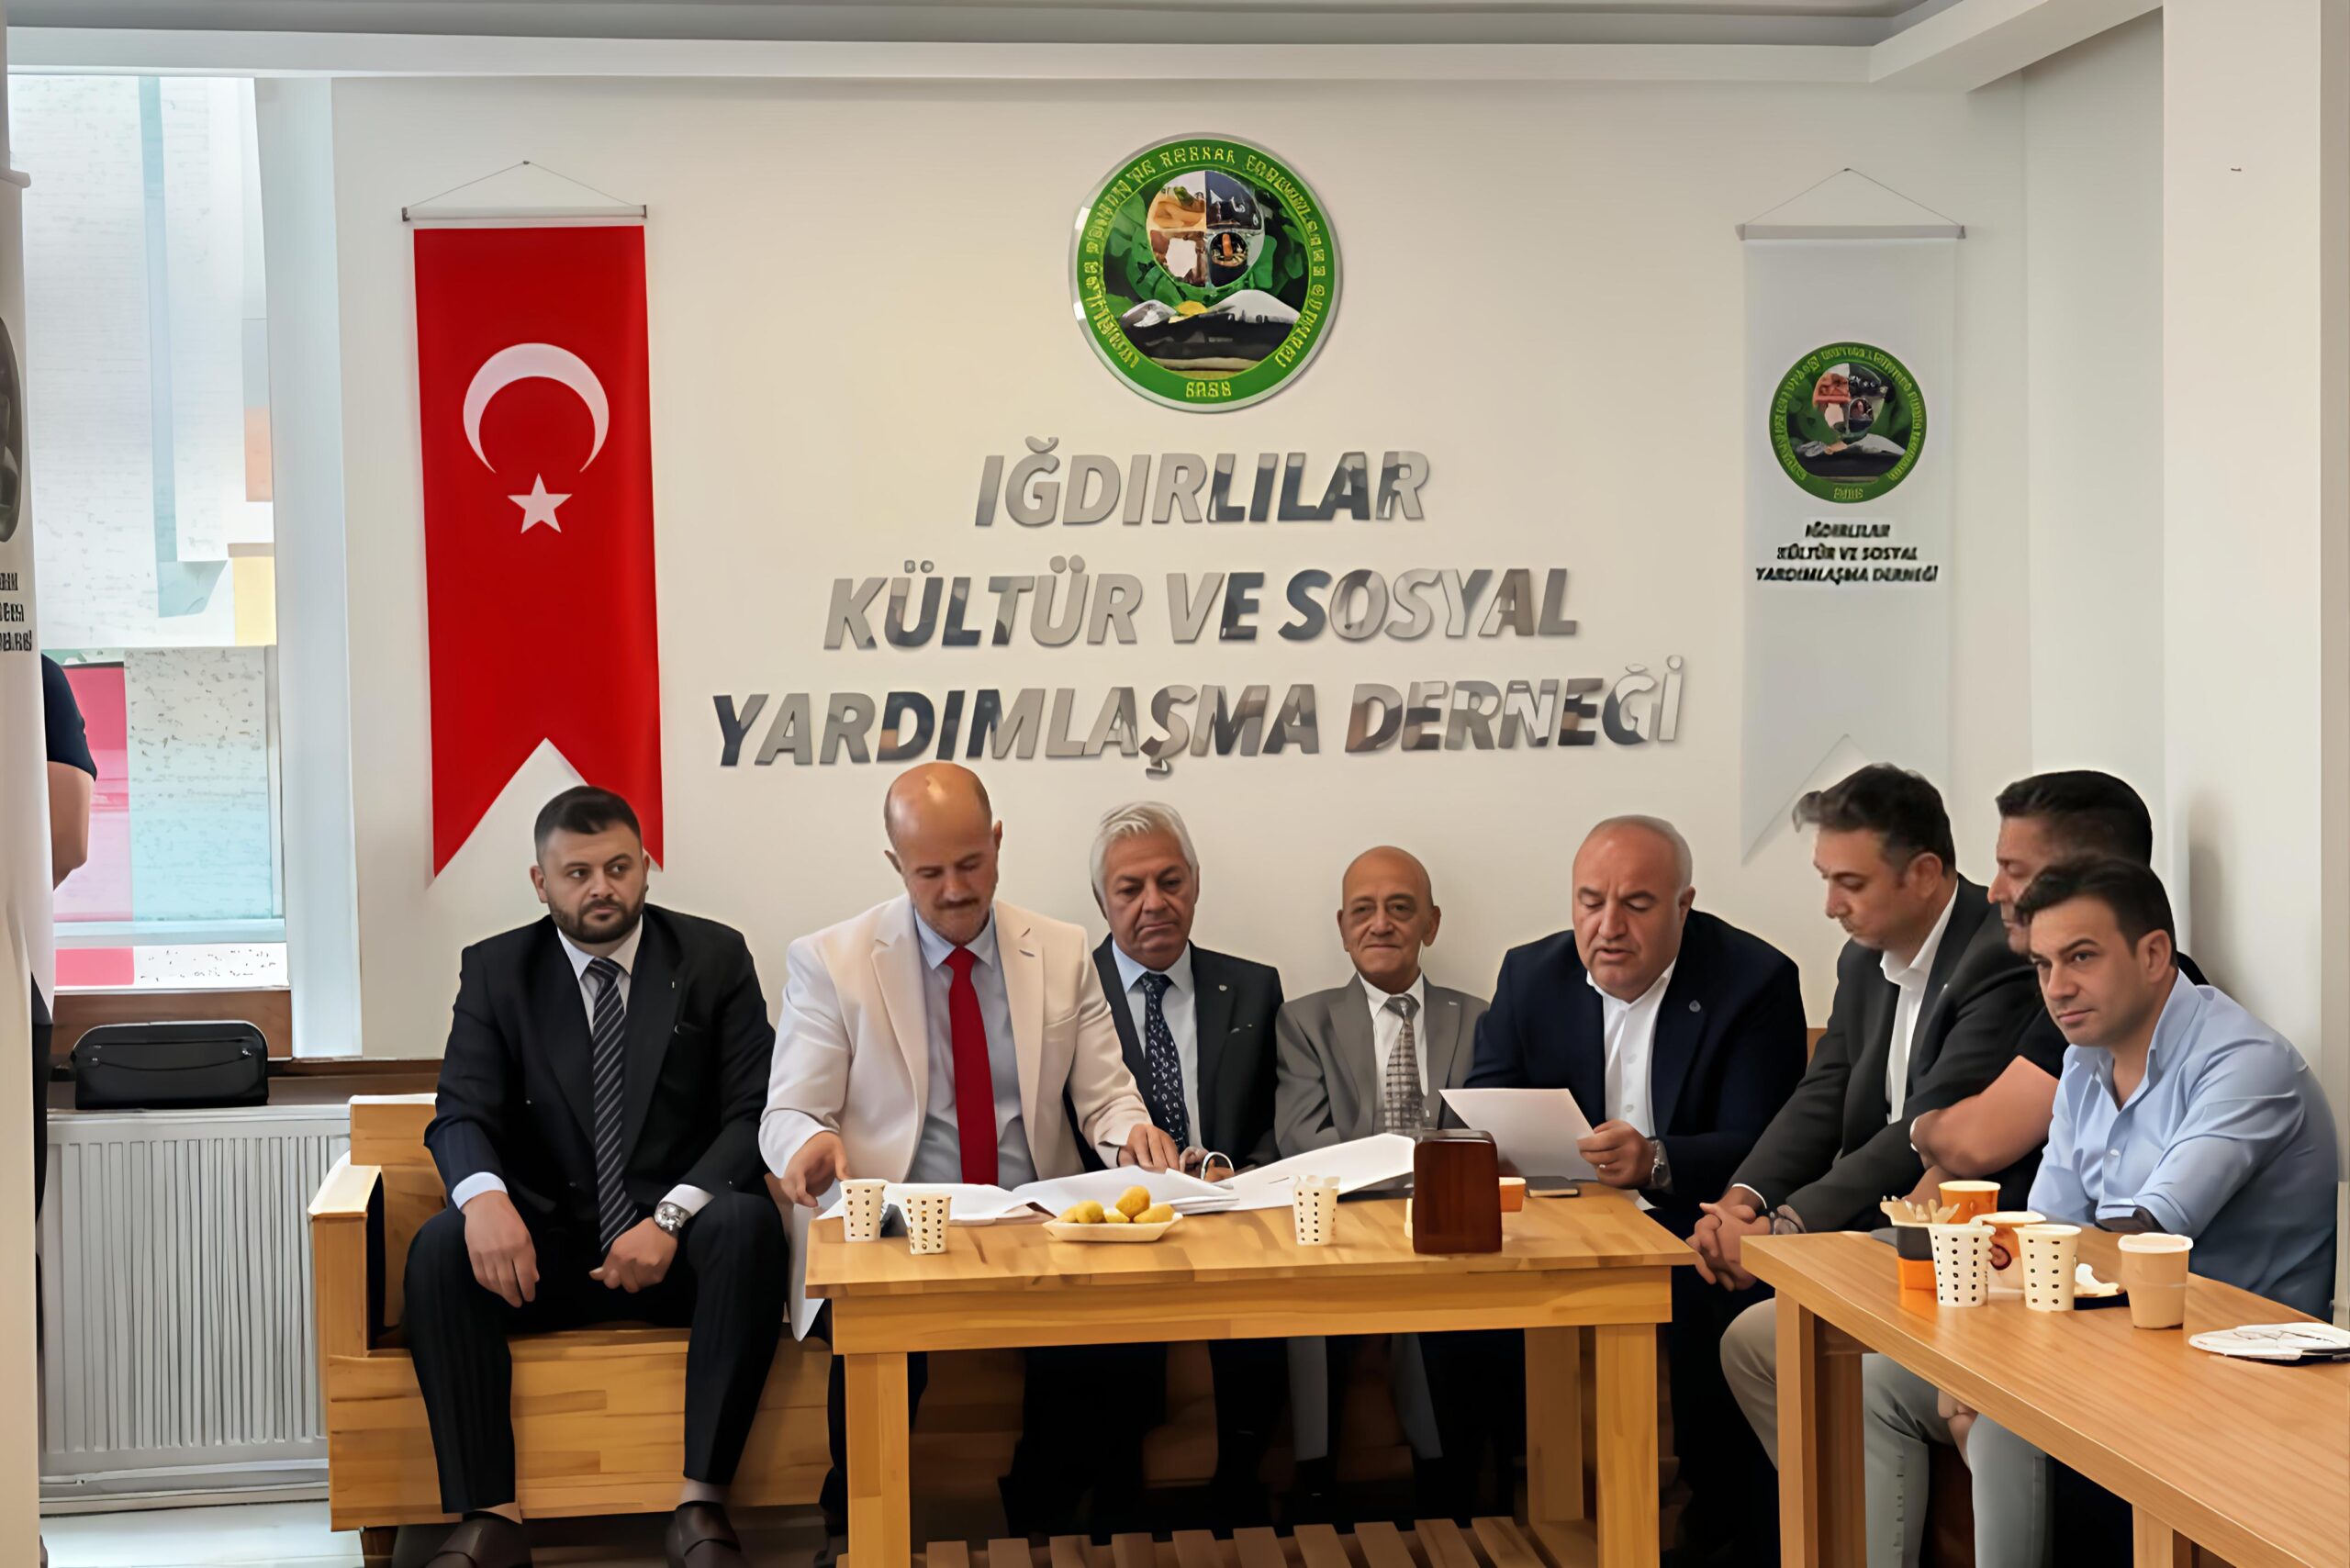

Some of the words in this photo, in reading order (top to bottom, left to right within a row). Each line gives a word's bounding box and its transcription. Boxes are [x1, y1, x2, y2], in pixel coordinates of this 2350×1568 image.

[975, 436, 1429, 526] IĞDIRLILAR
[822, 556, 1144, 650] KÜLTÜR
[1166, 572, 1265, 644] VE
[1278, 567, 1579, 642] SOSYAL
[712, 684, 1320, 778] YARDIMLAŞMA
[1344, 655, 1685, 753] DERNEĞİ
